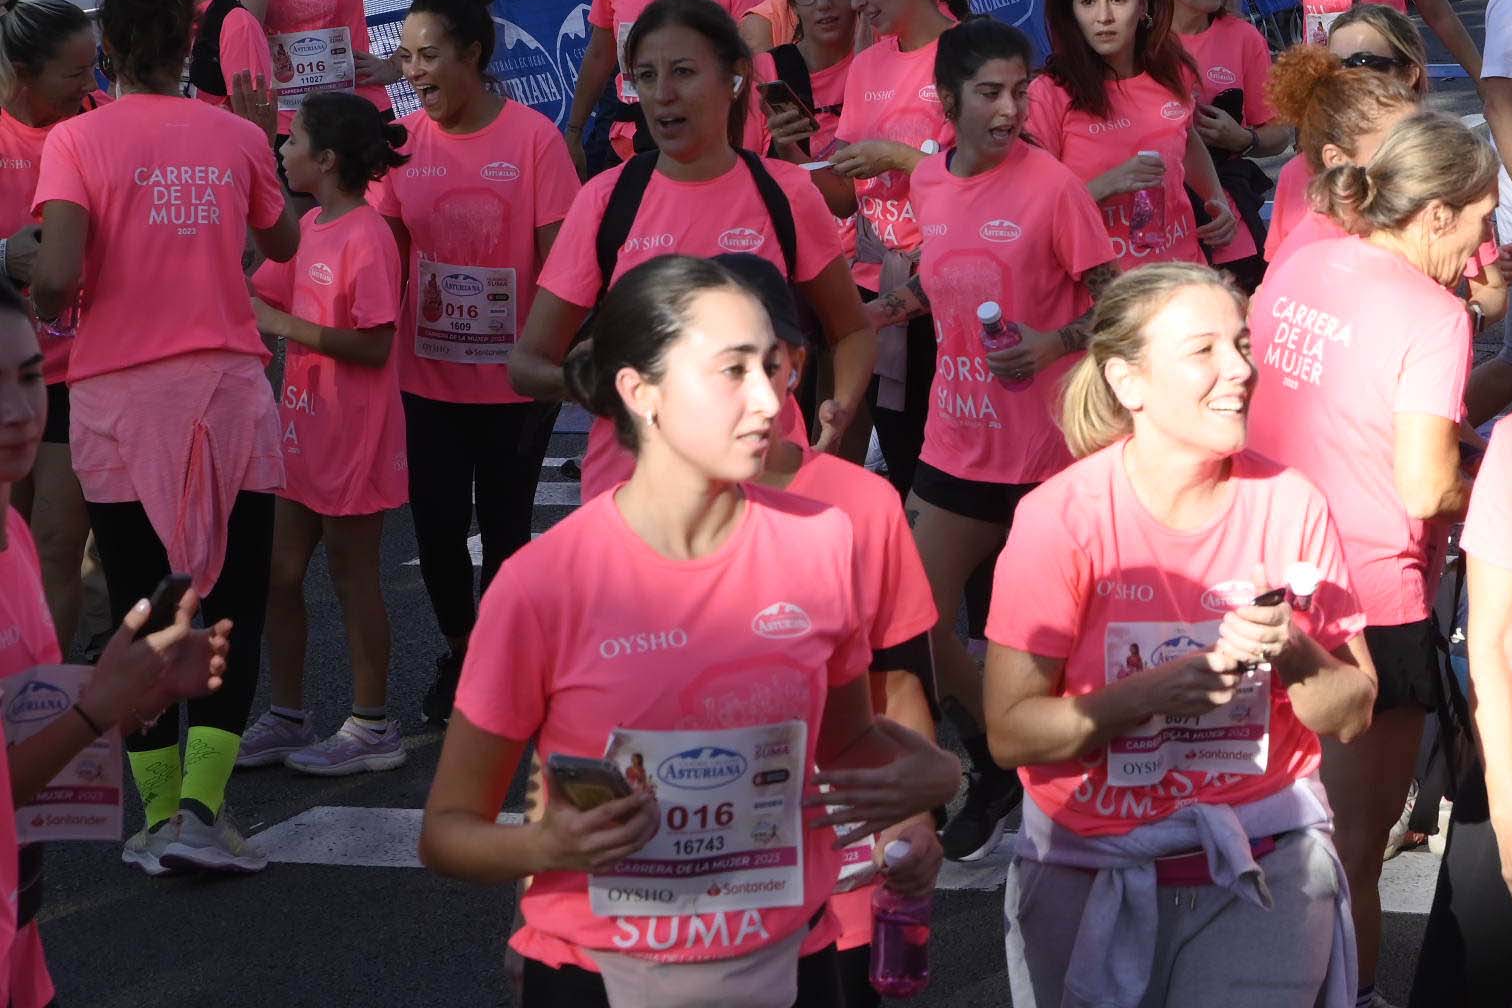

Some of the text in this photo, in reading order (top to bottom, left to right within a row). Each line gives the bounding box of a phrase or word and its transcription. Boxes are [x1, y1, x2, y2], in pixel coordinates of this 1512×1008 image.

[296, 61, 326, 74] 016
[300, 75, 324, 85] 11027
[1087, 117, 1132, 135] OYSHO
[134, 166, 235, 186] CARRERA
[405, 166, 447, 179] OYSHO
[153, 186, 217, 205] DE LA
[148, 205, 221, 225] MUJER
[443, 279, 483, 293] ASTURIANA
[445, 302, 479, 319] 016
[449, 321, 471, 332] 1609
[1272, 296, 1350, 347] CARRERA
[1274, 323, 1324, 362] DE LA
[1264, 344, 1324, 386] MUJER
[600, 628, 689, 660] OYSHO
[664, 763, 742, 781] ASTURIANA
[45, 814, 108, 827] Santander
[666, 802, 735, 832] 016
[672, 835, 726, 857] 16743
[614, 862, 673, 875] CARRERA
[676, 862, 693, 874] DE
[694, 861, 710, 873] LA
[711, 858, 752, 871] MUJER
[608, 879, 787, 904] OYSHO Santander
[611, 910, 769, 950] SUMA
